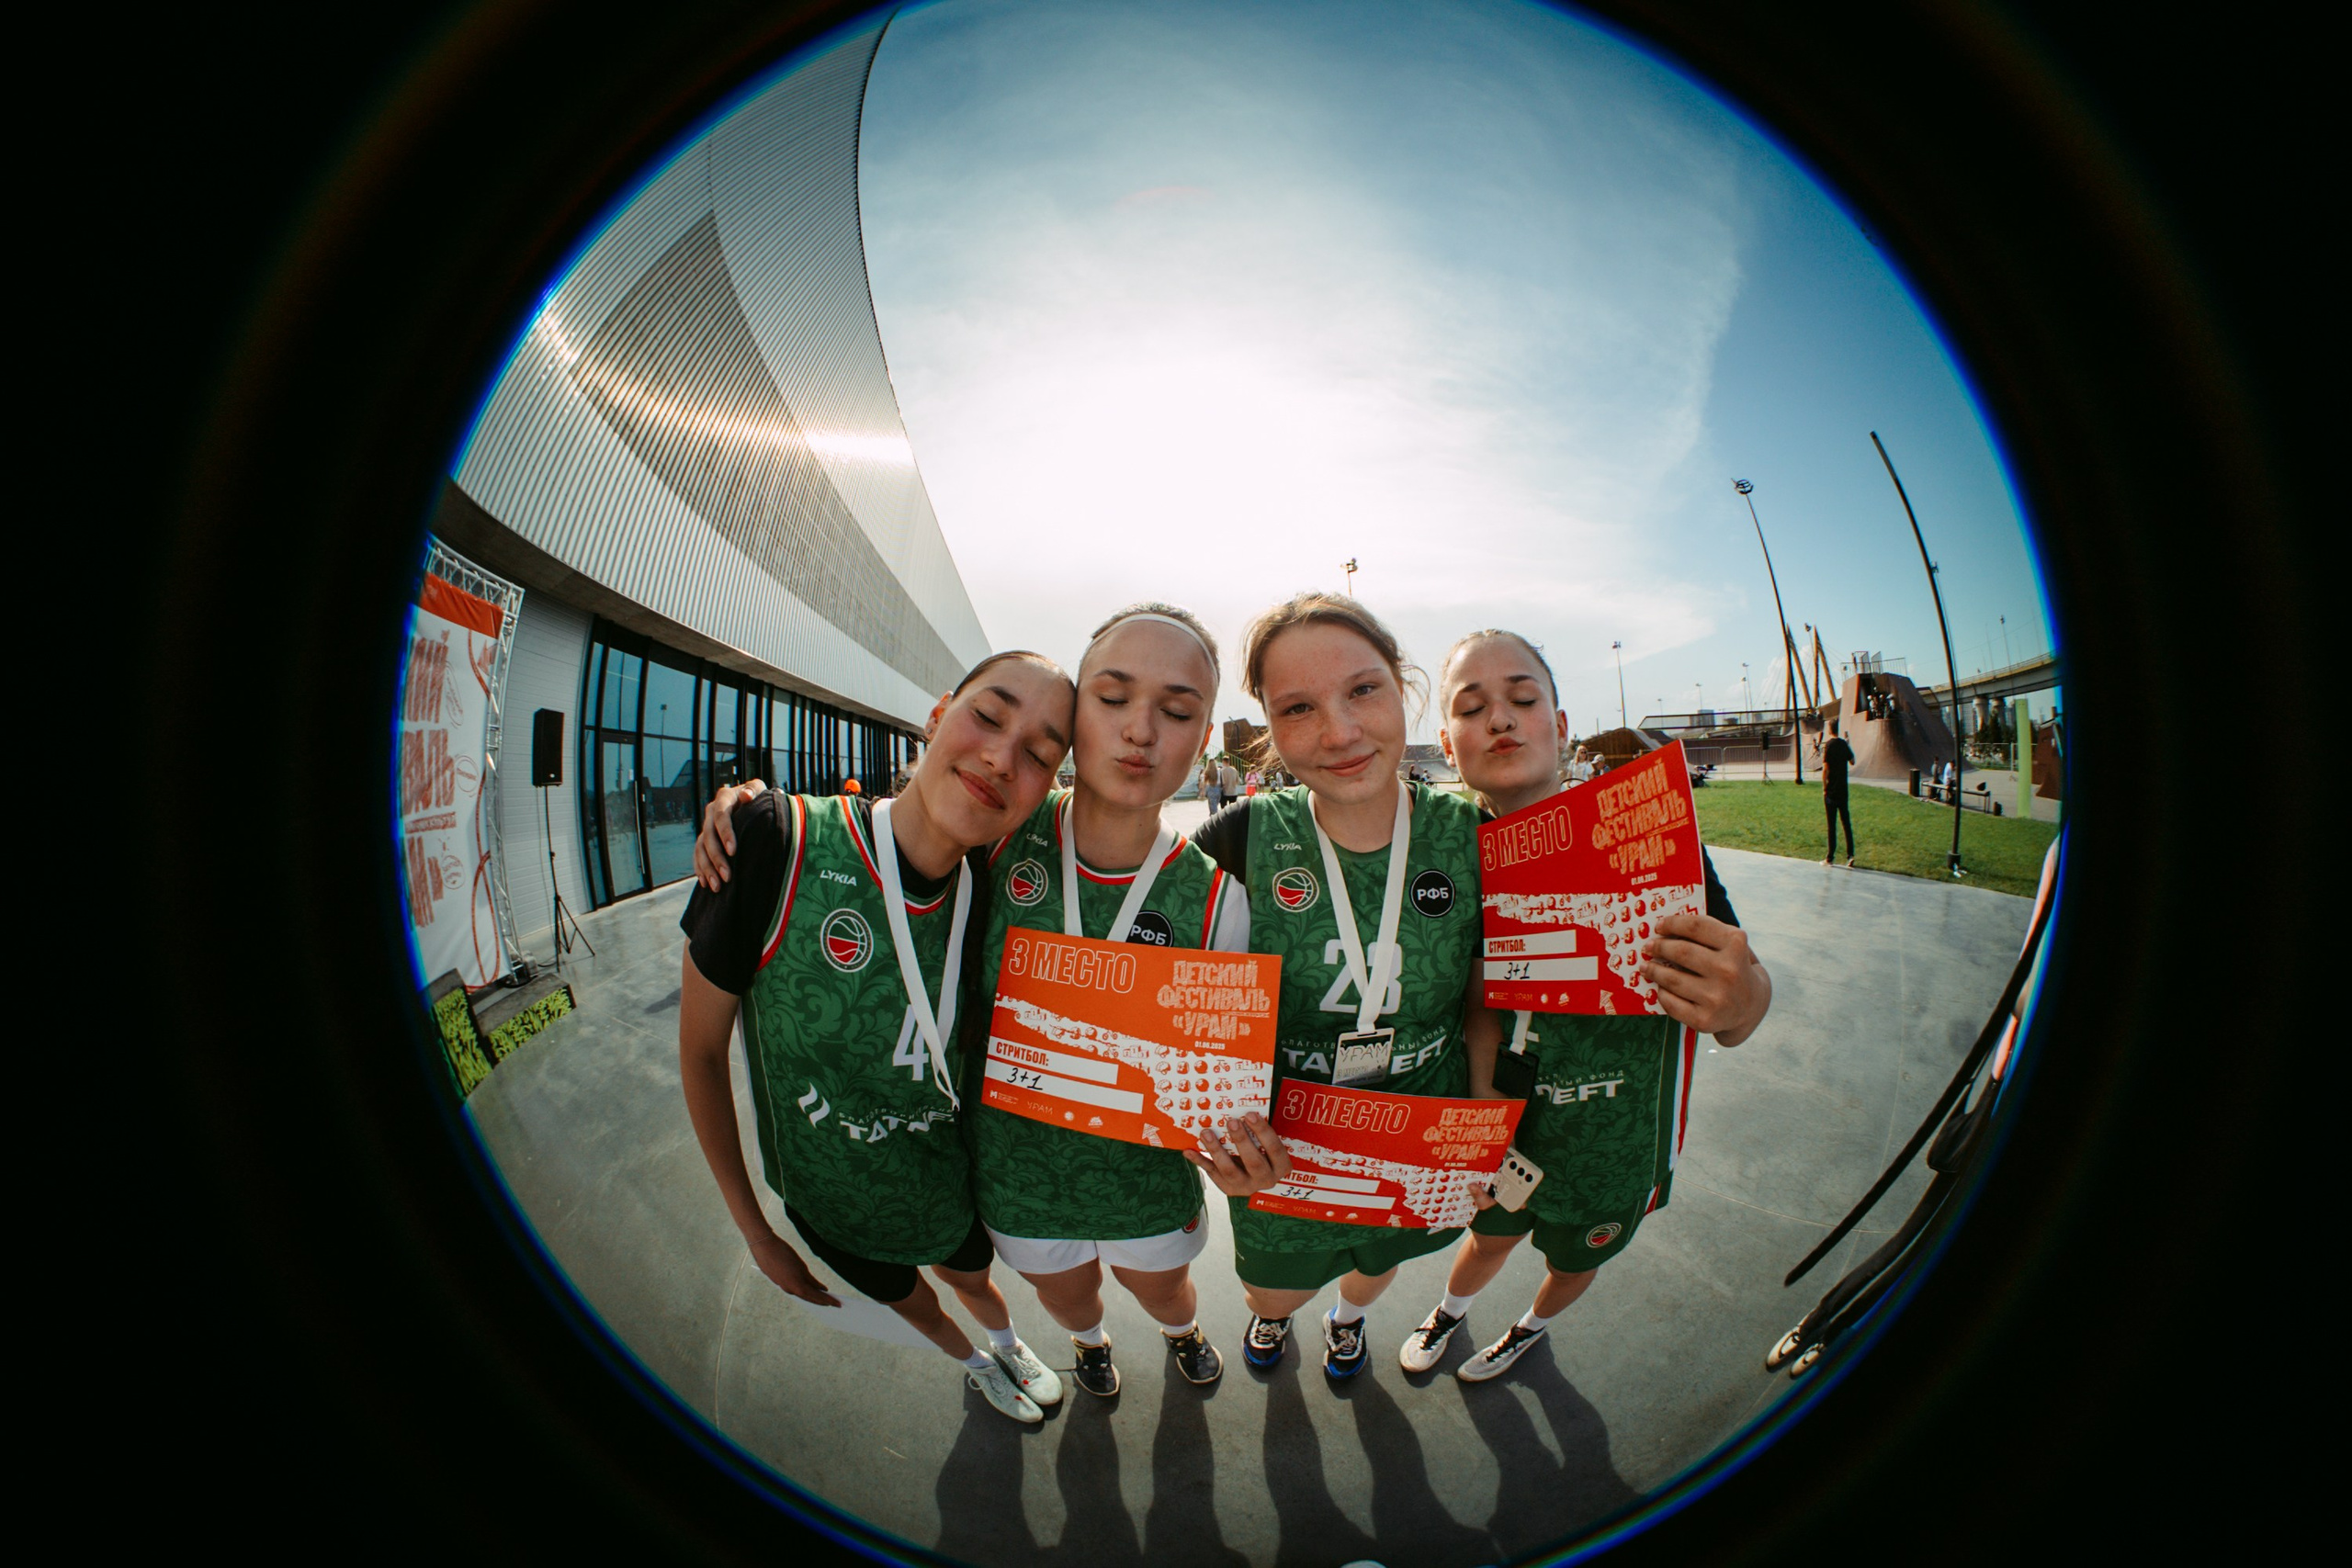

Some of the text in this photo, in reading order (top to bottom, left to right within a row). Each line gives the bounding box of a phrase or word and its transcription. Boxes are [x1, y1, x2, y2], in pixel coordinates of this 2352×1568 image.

[1596, 757, 1669, 822] ДЕТСКИЙ
[1591, 789, 1687, 850] ФЕСТИВАЛЬ
[1273, 842, 1302, 852] LYKIA
[1483, 806, 1573, 871] 3 МЕСТО
[820, 870, 857, 886] LYKIA
[1417, 887, 1449, 901] РФБ
[1130, 925, 1168, 946] РФБ
[1488, 939, 1526, 953] СТРИТБОЛ:
[1009, 938, 1136, 994] 3 МЕСТО
[1172, 959, 1258, 987] ДЕТСКИЙ
[1504, 962, 1531, 980] 3+1
[1157, 985, 1271, 1011] ФЕСТИВАЛЬ
[1172, 1011, 1250, 1040] «УРАМ»
[892, 1004, 930, 1081] 4
[996, 1042, 1049, 1066] СТРИТБОЛ:
[1282, 1035, 1447, 1075] TAEFT
[1006, 1067, 1043, 1090] 3+1
[1589, 1069, 1624, 1081] ФОНД
[1283, 1089, 1411, 1134] 3 МЕСТО
[1438, 1105, 1508, 1127] ДЕТСКИЙ
[1422, 1125, 1509, 1143] ФЕСТИВАЛЬ
[1281, 1187, 1314, 1200] 3+1
